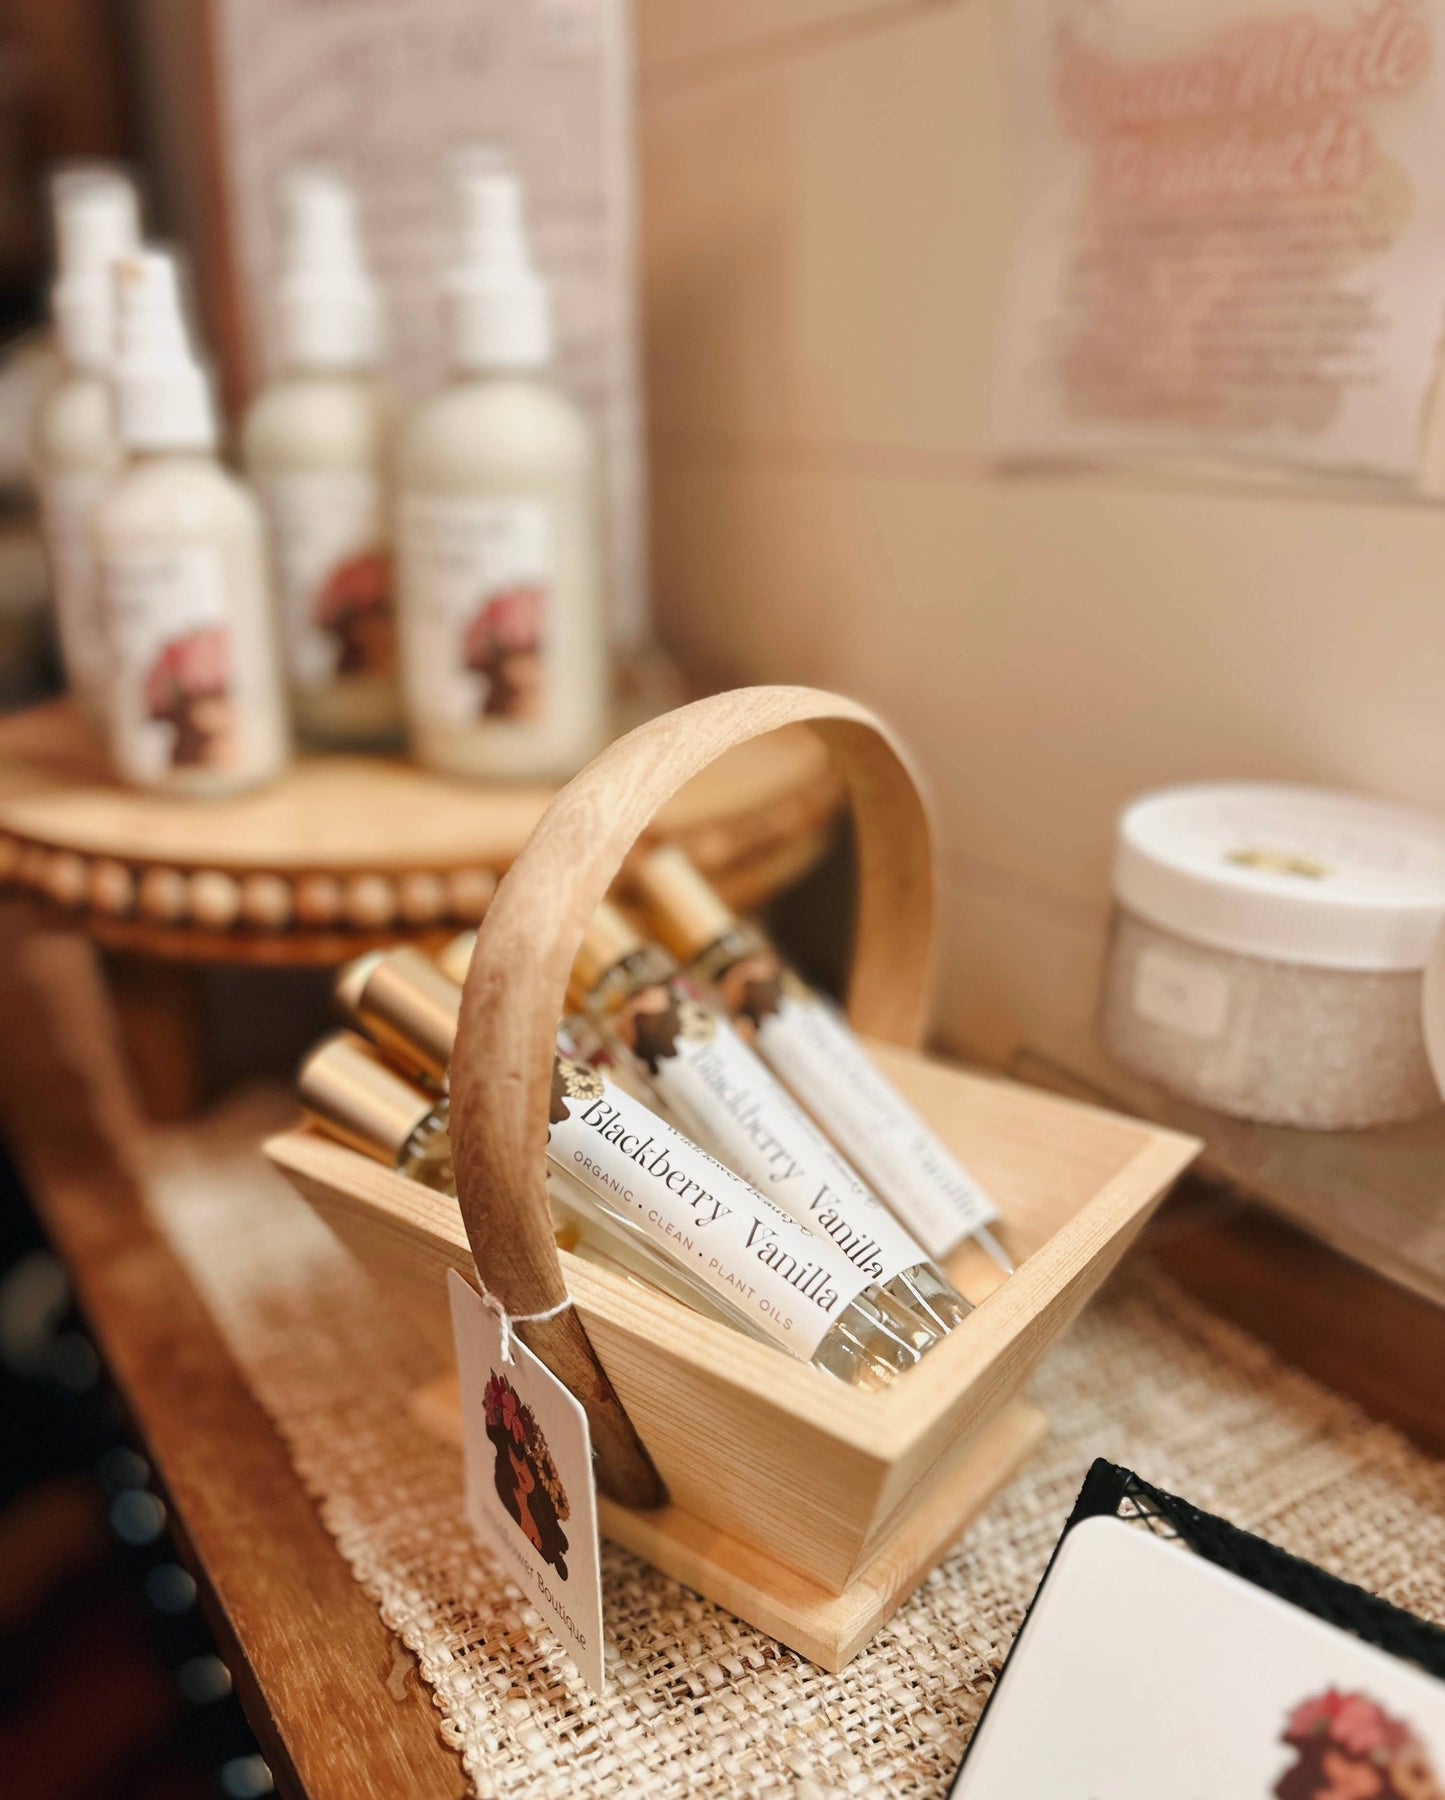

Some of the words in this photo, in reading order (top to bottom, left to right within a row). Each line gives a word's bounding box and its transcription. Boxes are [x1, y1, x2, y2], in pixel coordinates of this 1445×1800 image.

[573, 1150, 634, 1203] ORGANIC
[647, 1209, 694, 1250] CLEAN
[707, 1257, 757, 1300] PLANT
[758, 1298, 794, 1331] OILS
[579, 1098, 734, 1228] Blackberry
[744, 1216, 839, 1314] Vanilla
[809, 1184, 884, 1280] Vanilla
[536, 1571, 587, 1651] Boutique
